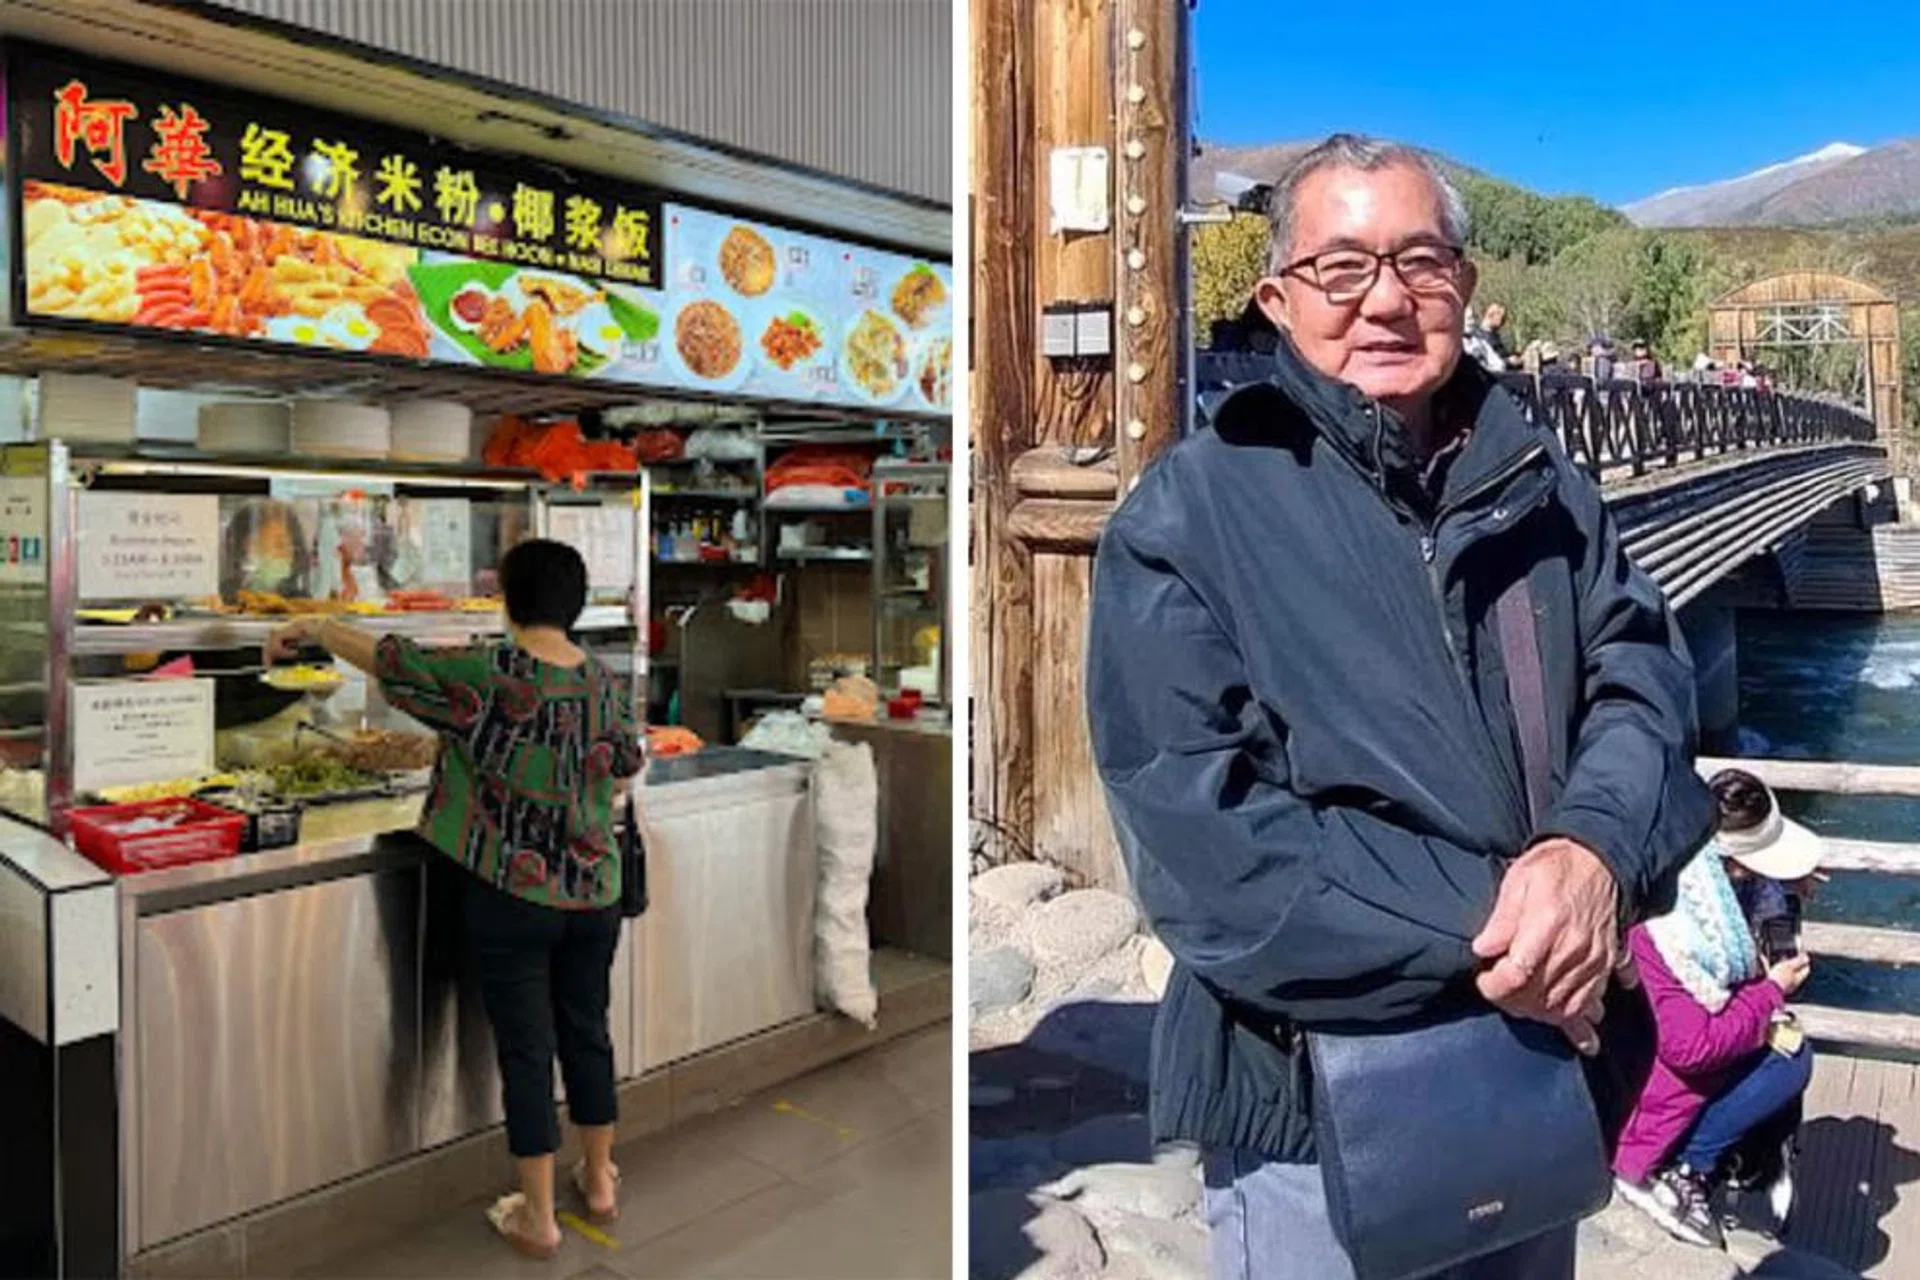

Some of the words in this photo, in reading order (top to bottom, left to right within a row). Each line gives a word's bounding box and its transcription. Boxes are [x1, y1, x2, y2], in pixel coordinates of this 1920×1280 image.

[53, 79, 223, 201] 阿華
[238, 189, 270, 214] AH
[273, 194, 334, 224] HUA'S
[338, 207, 414, 240] KITCHEN
[417, 222, 469, 249] ECON
